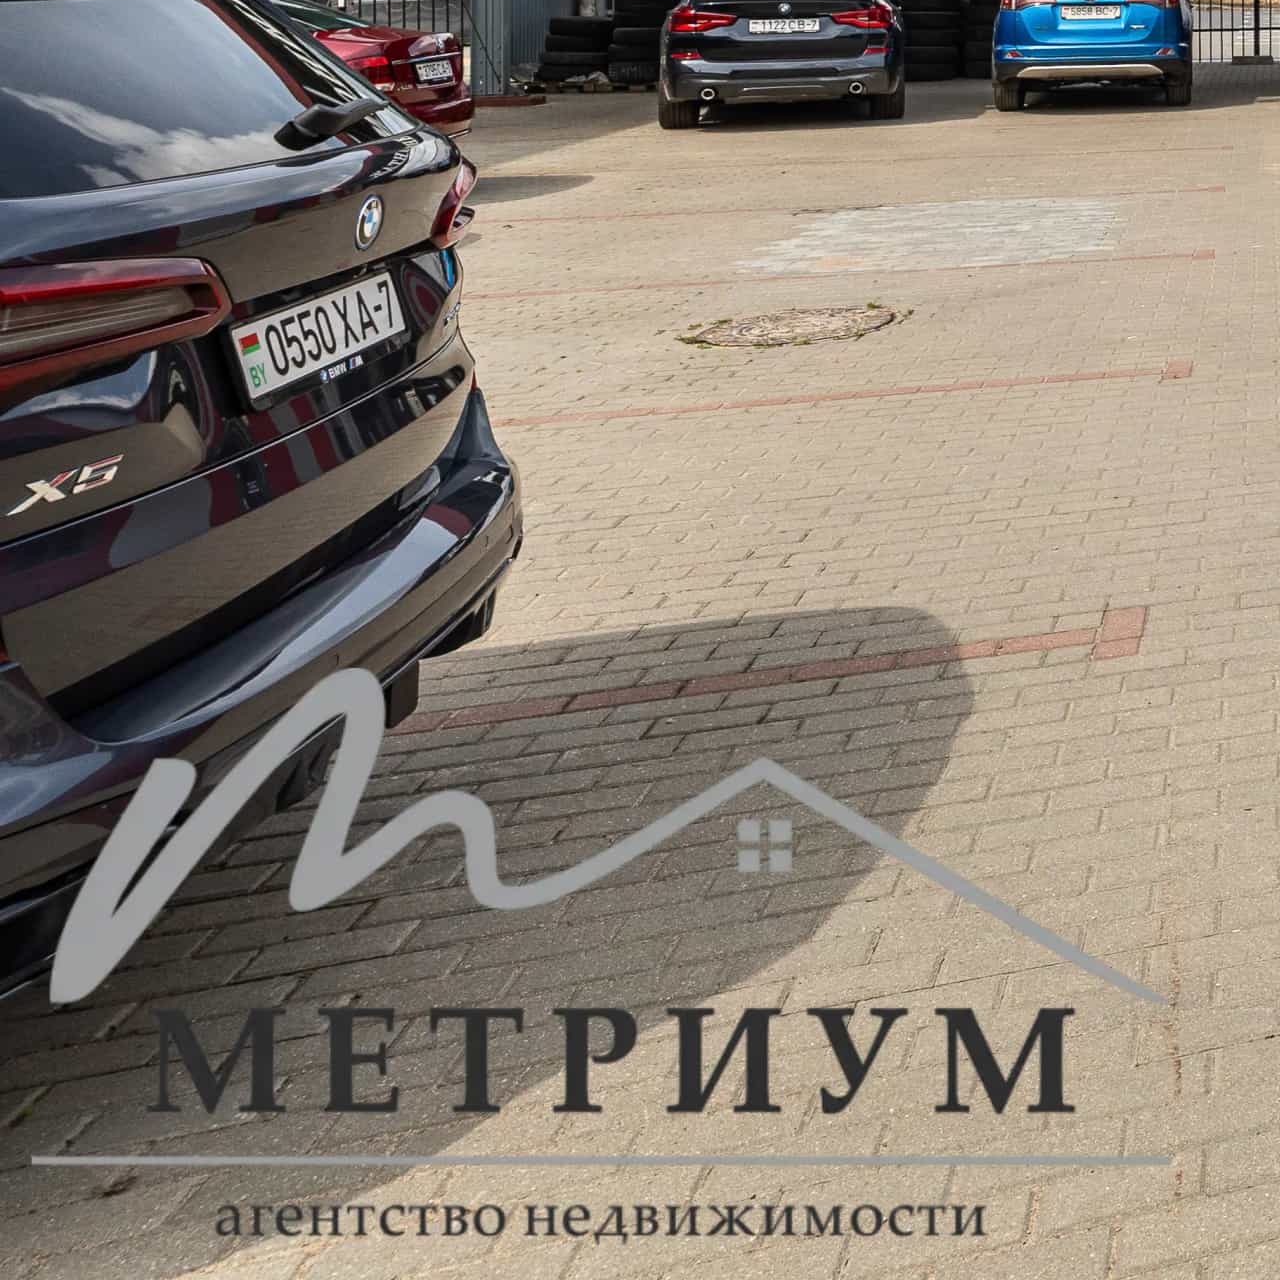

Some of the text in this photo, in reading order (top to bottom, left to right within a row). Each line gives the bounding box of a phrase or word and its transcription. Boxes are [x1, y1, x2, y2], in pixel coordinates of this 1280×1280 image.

[249, 363, 268, 388] BY
[328, 362, 347, 380] BMW
[5, 453, 124, 516] X5
